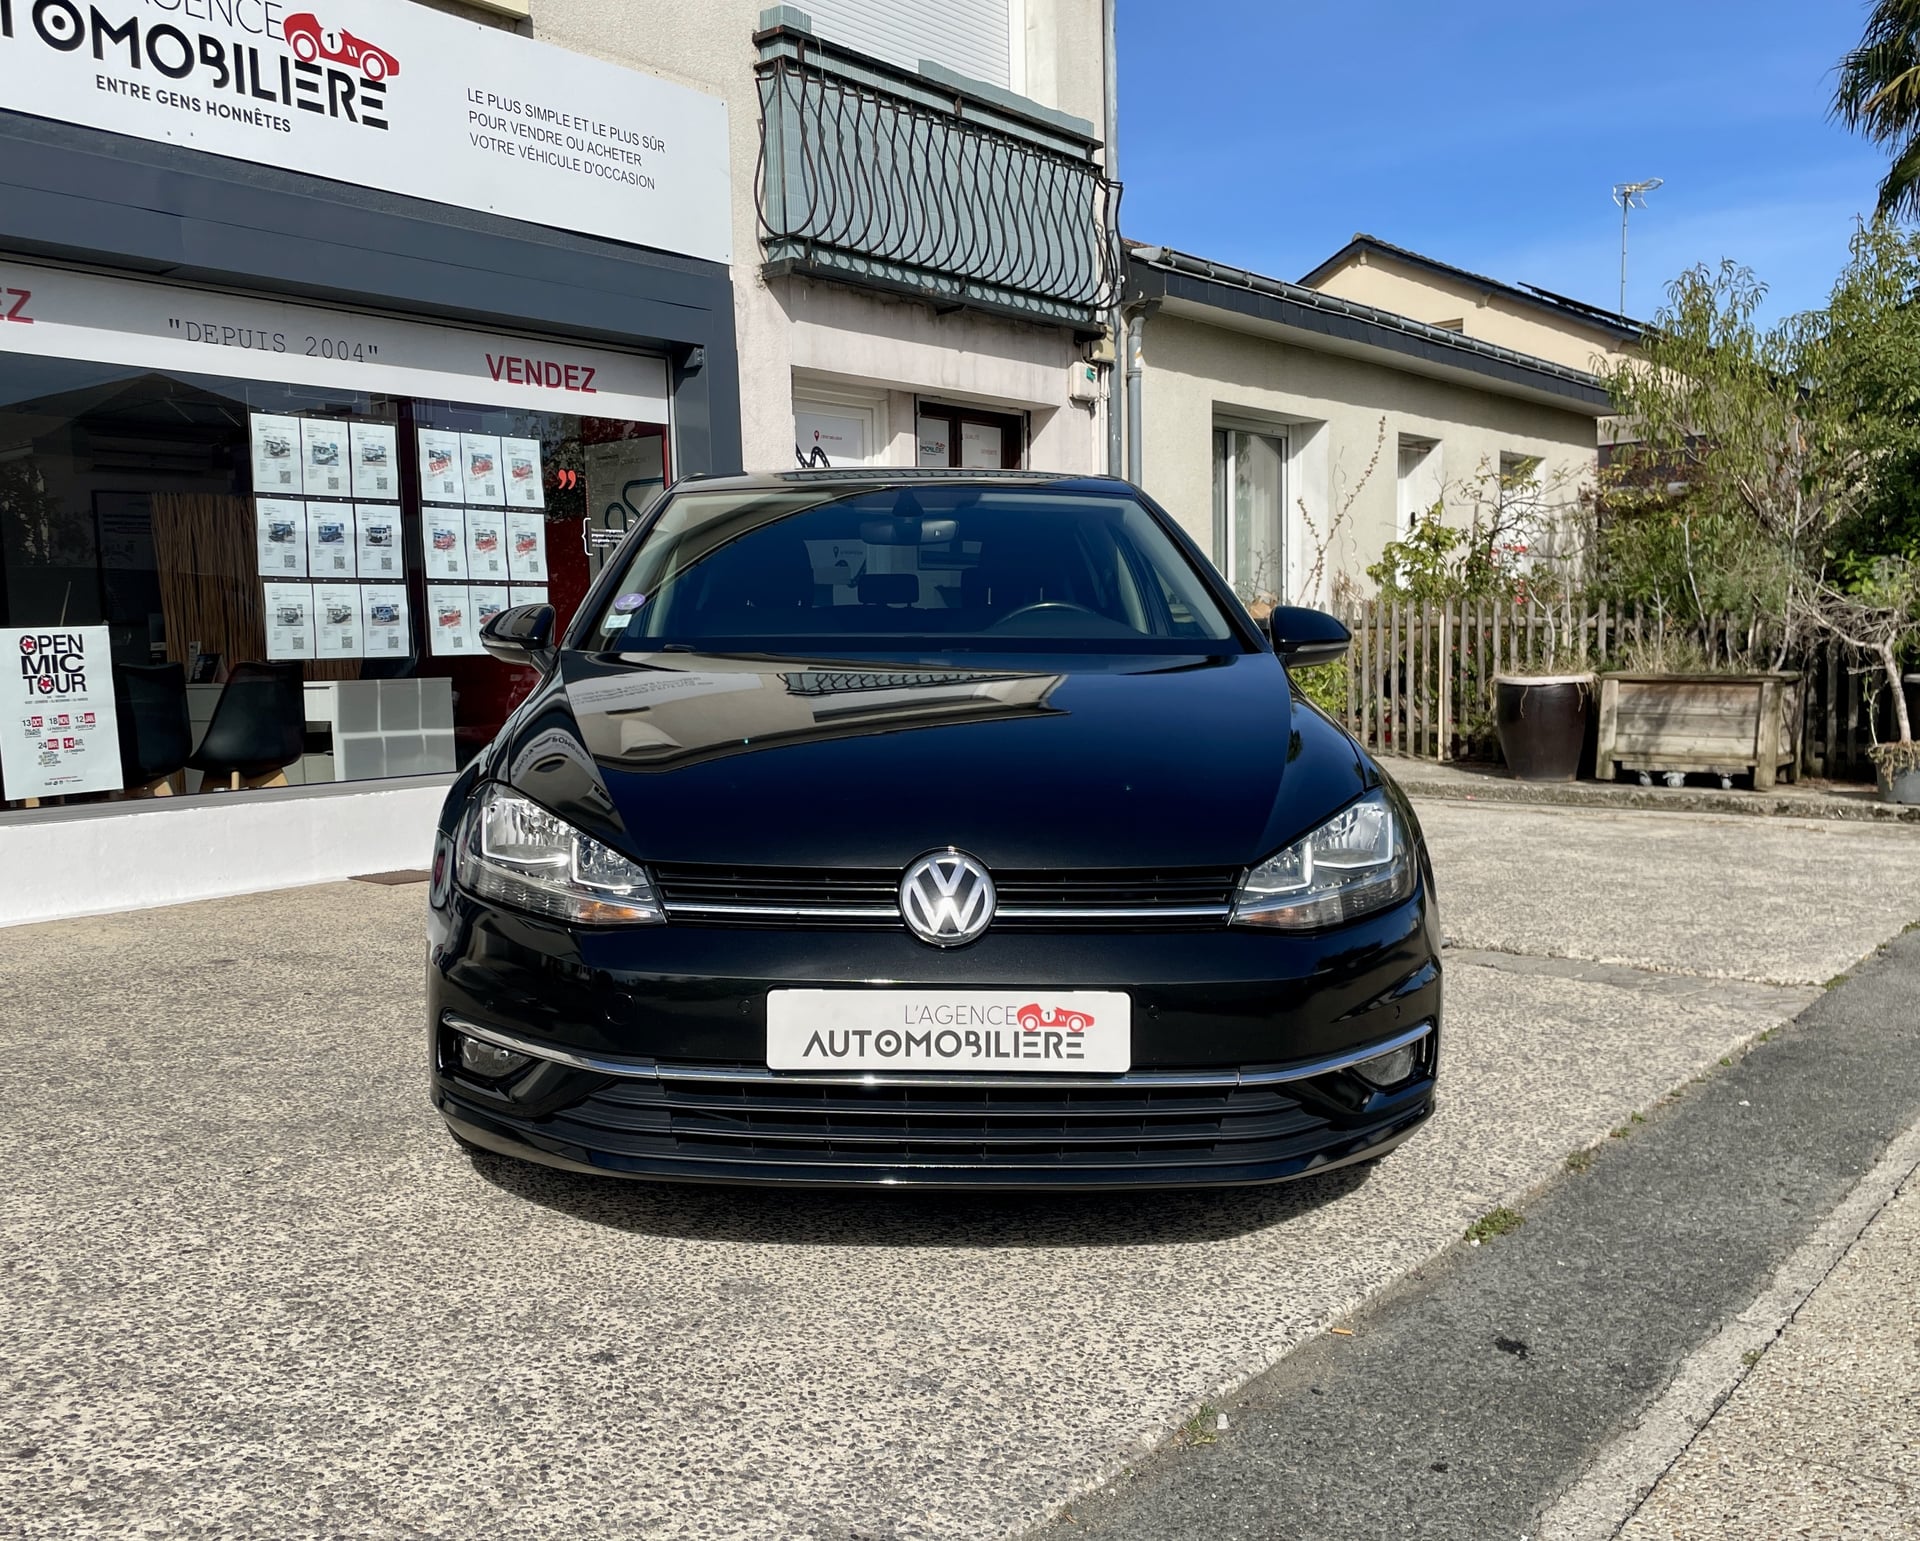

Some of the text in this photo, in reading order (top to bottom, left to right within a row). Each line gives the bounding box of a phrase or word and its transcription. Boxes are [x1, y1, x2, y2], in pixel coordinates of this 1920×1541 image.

[145, 0, 285, 41] ENCE
[96, 74, 292, 134] ENTRE GENS HONNÊTES
[467, 87, 666, 153] LE PLUS SIMPLE ET LE PLUS SÛR
[469, 110, 642, 167] POUR VENDRE OU ACHETER
[469, 132, 655, 190] VOTRE VÉHICULE D'OCCASION
[0, 286, 34, 324] Z
[485, 353, 597, 393] VENDEZ
[19, 633, 84, 656] OPEN
[20, 653, 85, 675] MIC
[22, 673, 87, 695] TOUR
[22, 719, 31, 727] 13
[49, 717, 58, 725] 18
[75, 715, 84, 723] 12
[64, 739, 74, 747] 14
[905, 1005, 1017, 1025] L'AGENCE
